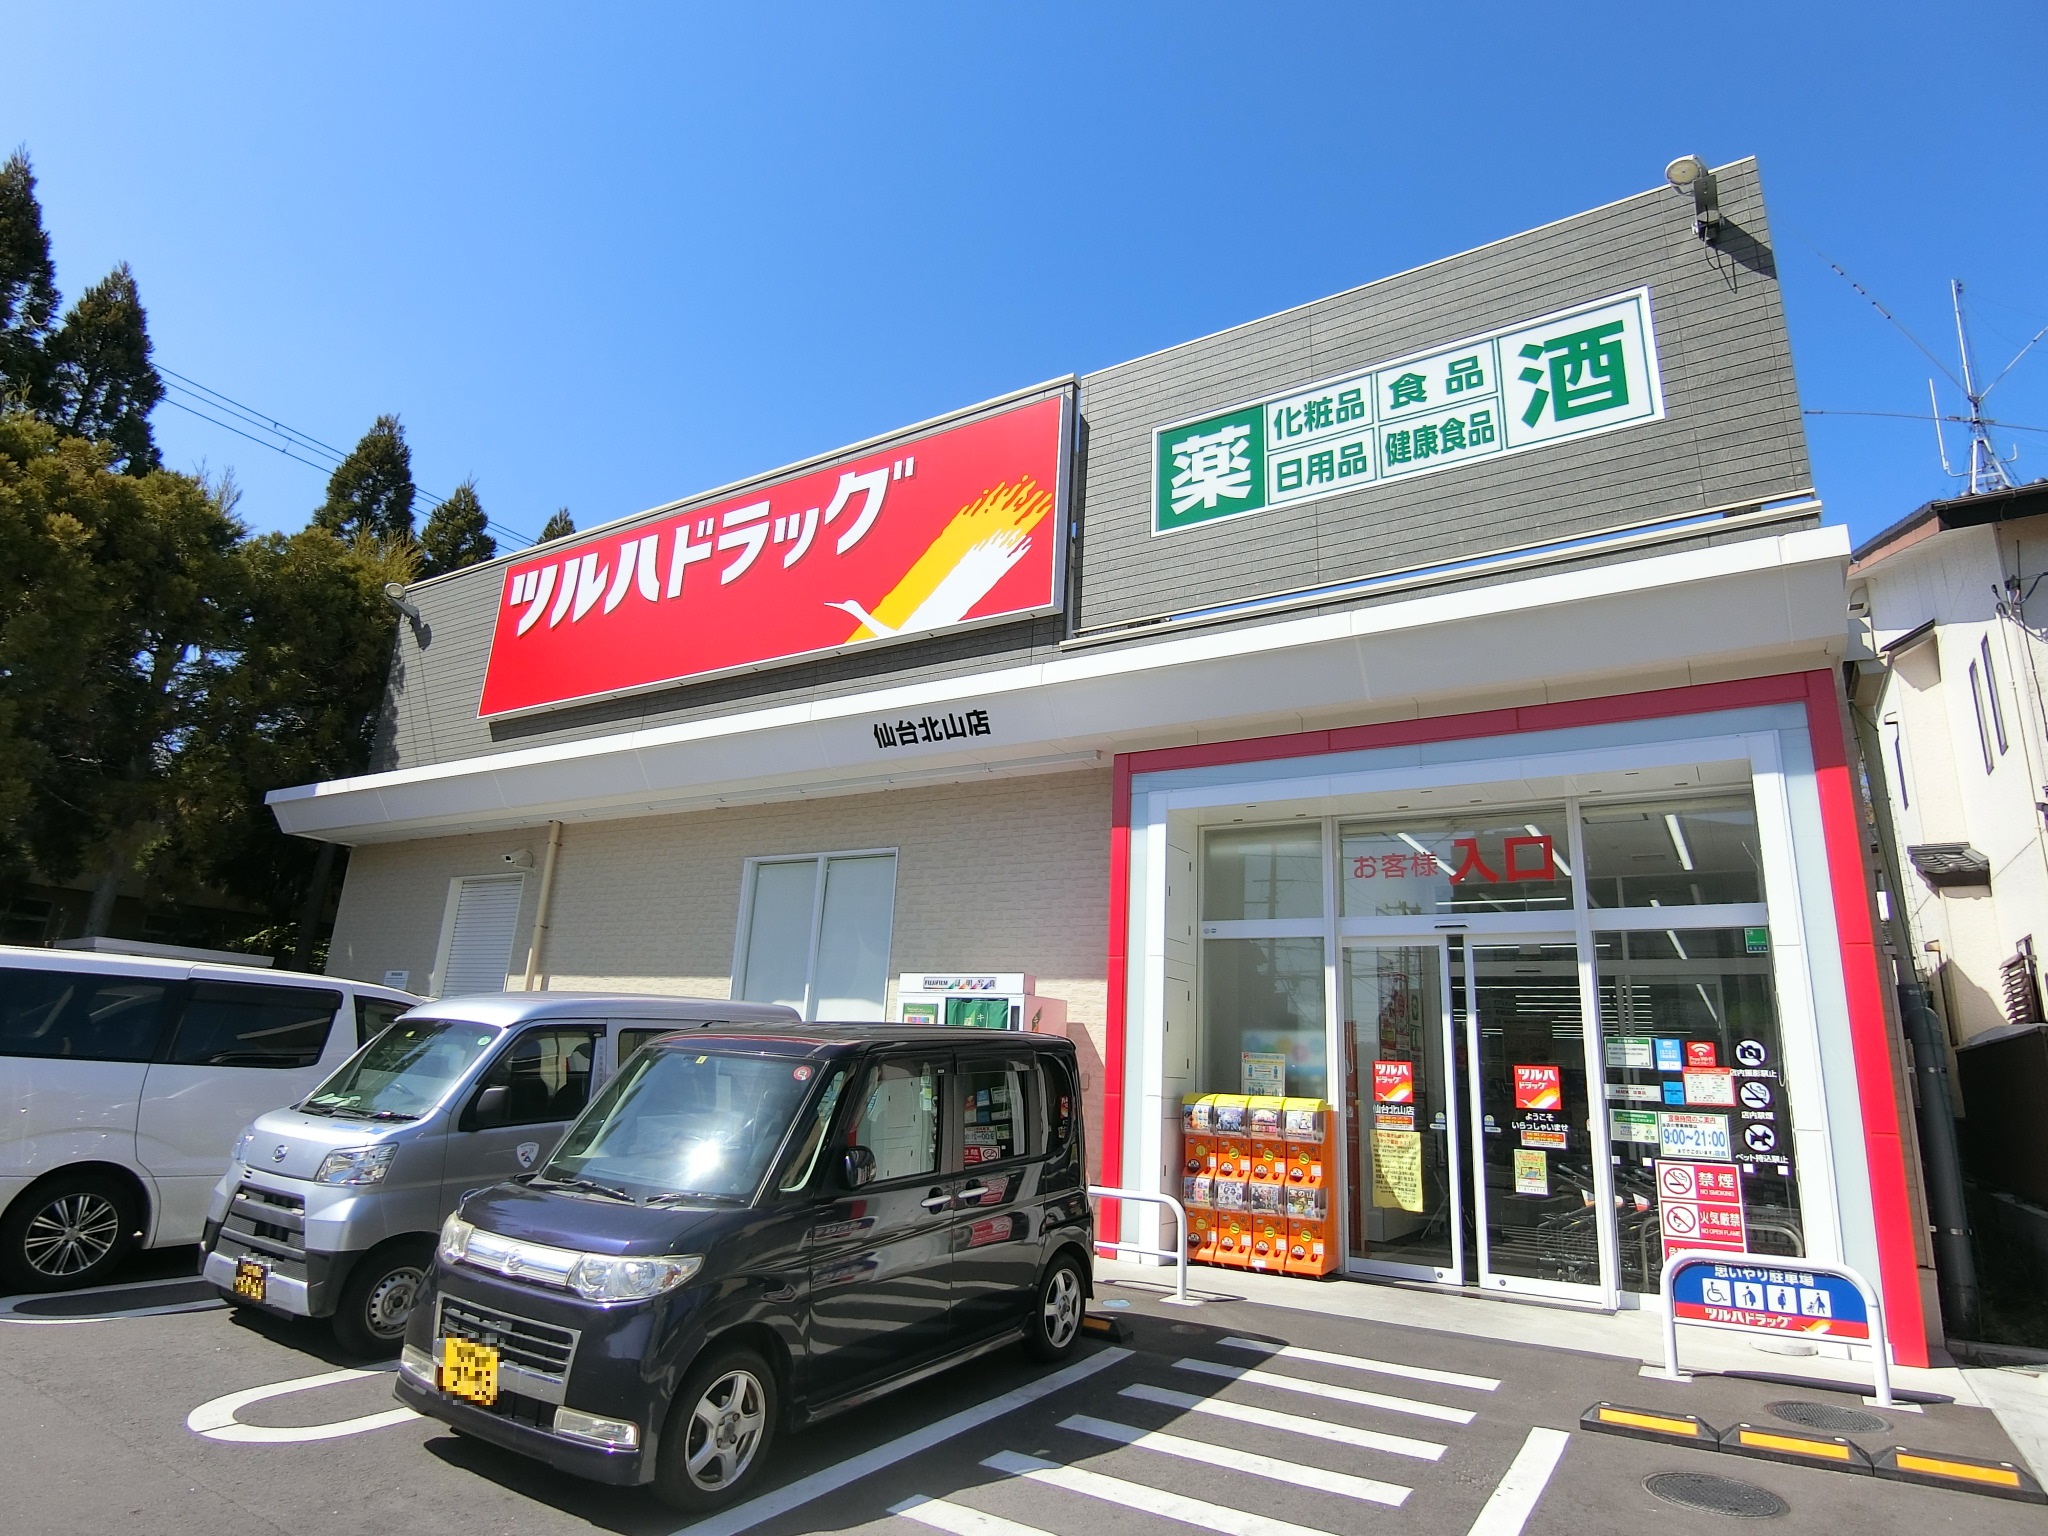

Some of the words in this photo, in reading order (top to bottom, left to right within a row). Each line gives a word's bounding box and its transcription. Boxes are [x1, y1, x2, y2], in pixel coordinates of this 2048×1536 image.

[1388, 355, 1484, 409] 食品
[1518, 320, 1630, 428] 酒
[1273, 387, 1366, 441] 化粧品
[1384, 409, 1495, 467] 健康食品
[1170, 423, 1253, 515] 薬
[1276, 440, 1368, 493] 日用品
[510, 456, 915, 638] ツルハドラッグ
[873, 709, 992, 749] 仙台北山店
[1353, 851, 1438, 880] お客様
[1448, 835, 1555, 885] 入口
[1375, 1064, 1409, 1075] ツルハ
[1517, 1068, 1555, 1081] ツルハ
[1375, 1076, 1401, 1084] ドラッグ
[1519, 1081, 1548, 1090] ドラッグ
[1373, 1104, 1415, 1115] 仙台北山店
[1525, 1112, 1554, 1121] ようこそ
[1741, 1111, 1774, 1120] 店内禁煙
[1511, 1122, 1568, 1131] いらっしゃいませ
[1668, 1115, 1716, 1124] 営業時間のご案内
[1735, 1154, 1789, 1164] ペット持込禁止
[1698, 1172, 1734, 1189] 禁煙
[1700, 1211, 1741, 1227] 火気厳禁
[1714, 1265, 1815, 1287] 思いやり駐車場
[1704, 1307, 1793, 1328] ツルハドラッグ
